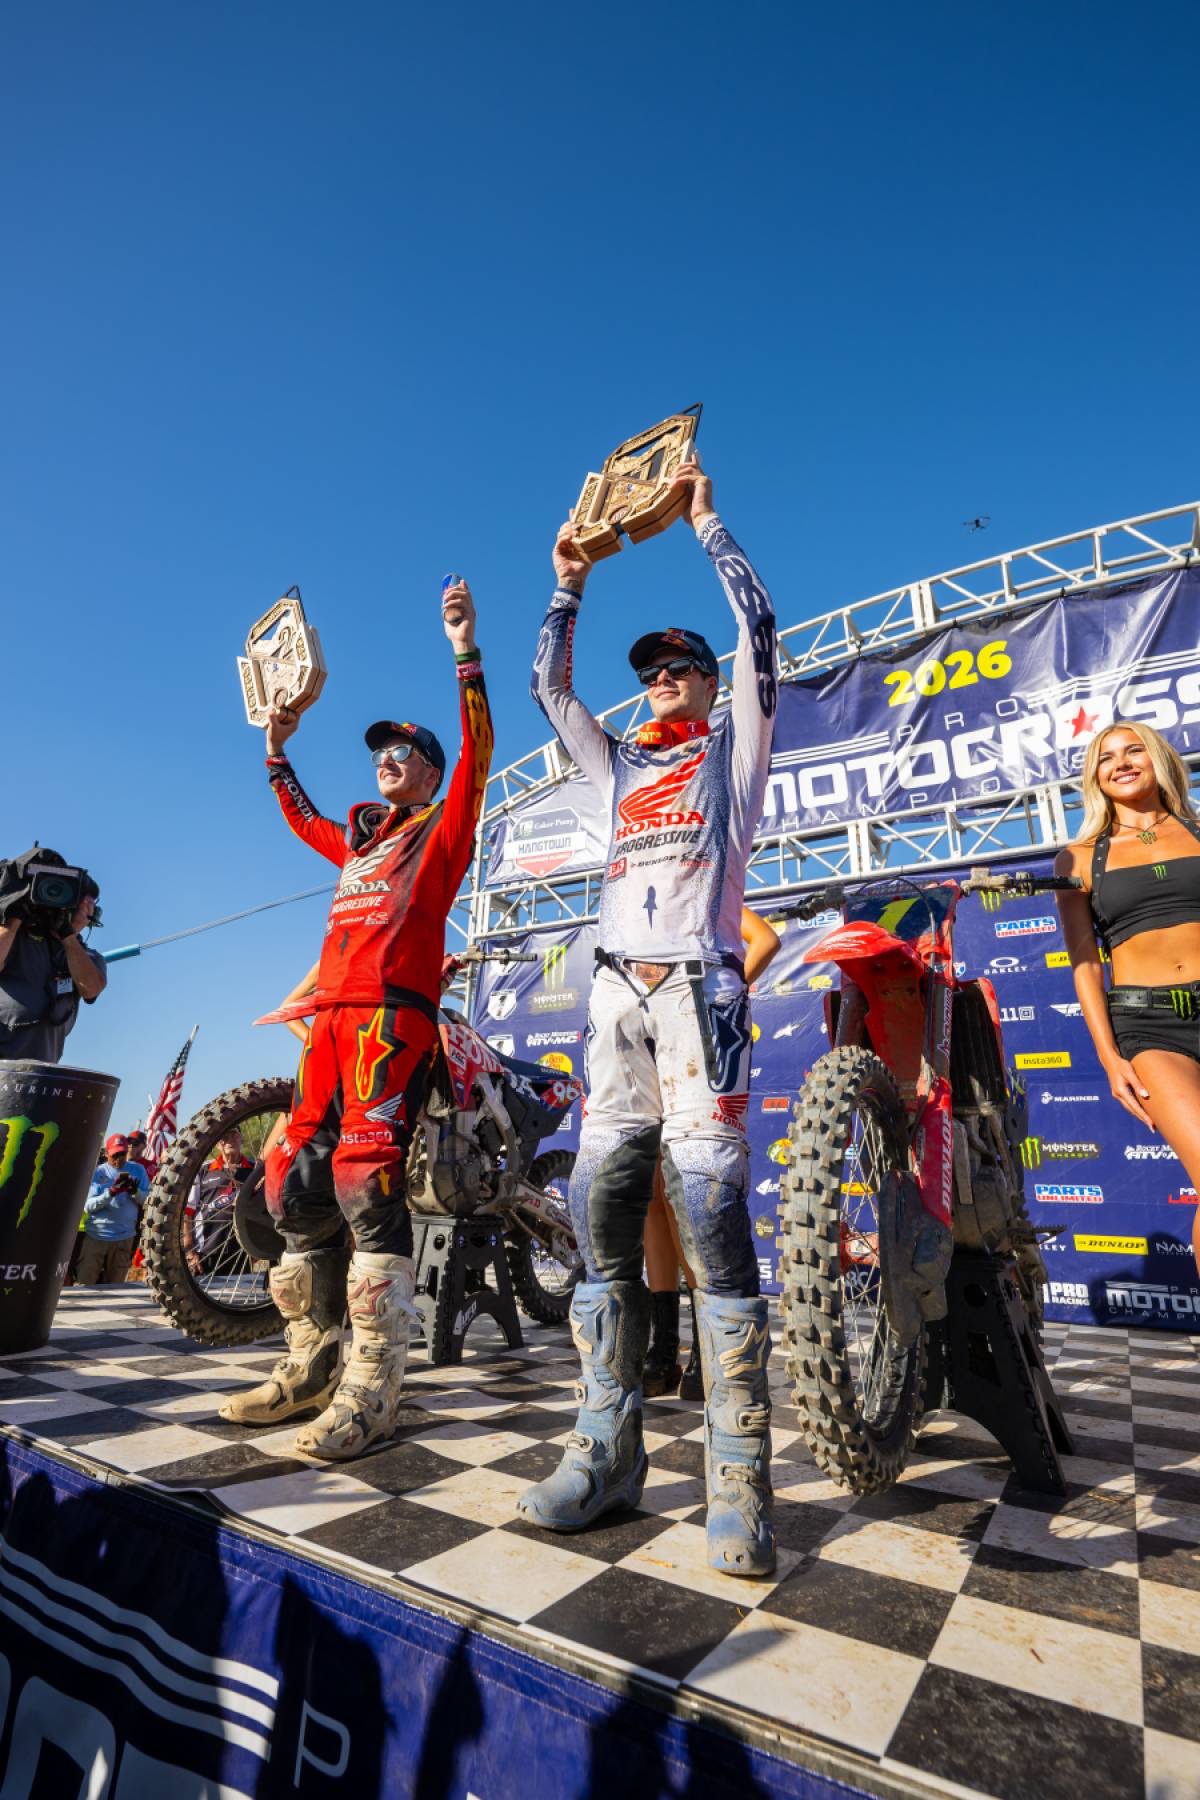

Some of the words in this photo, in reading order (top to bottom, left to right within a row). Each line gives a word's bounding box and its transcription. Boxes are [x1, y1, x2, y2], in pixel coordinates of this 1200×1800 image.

[883, 640, 1013, 708] 2026
[896, 696, 1019, 742] PRO
[616, 811, 706, 841] HONDA
[518, 837, 572, 854] HANGTOWN
[995, 917, 1055, 931] PARTS
[983, 966, 1028, 976] OAKLEY
[1023, 1056, 1062, 1065] Insta360
[1042, 1142, 1098, 1153] MONSTER
[1036, 1186, 1101, 1196] PARTS
[1087, 1239, 1144, 1250] DUNLOP
[1050, 1282, 1089, 1298] PRO
[1052, 1296, 1090, 1307] RACING
